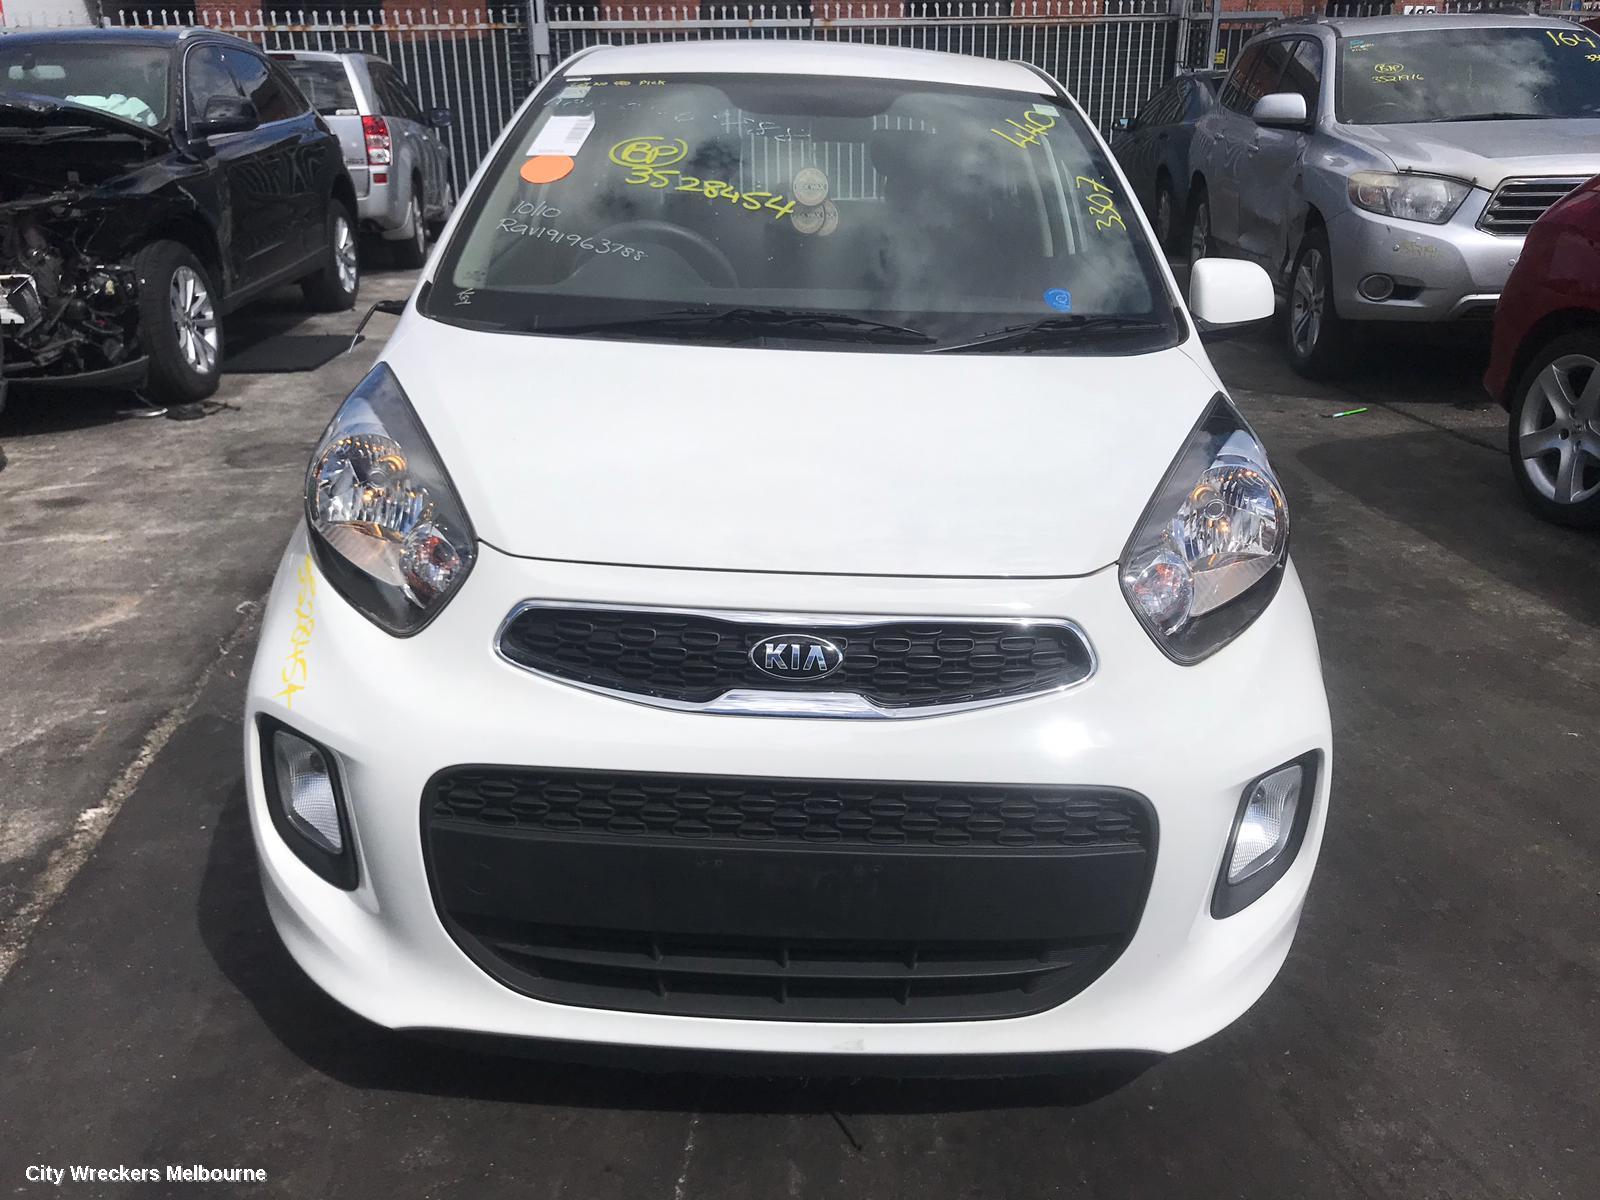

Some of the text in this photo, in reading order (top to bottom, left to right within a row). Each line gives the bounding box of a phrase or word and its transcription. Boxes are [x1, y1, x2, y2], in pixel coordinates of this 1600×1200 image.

[625, 165, 796, 219] 3528454
[512, 200, 562, 218] 10/10
[765, 643, 828, 671] KIA
